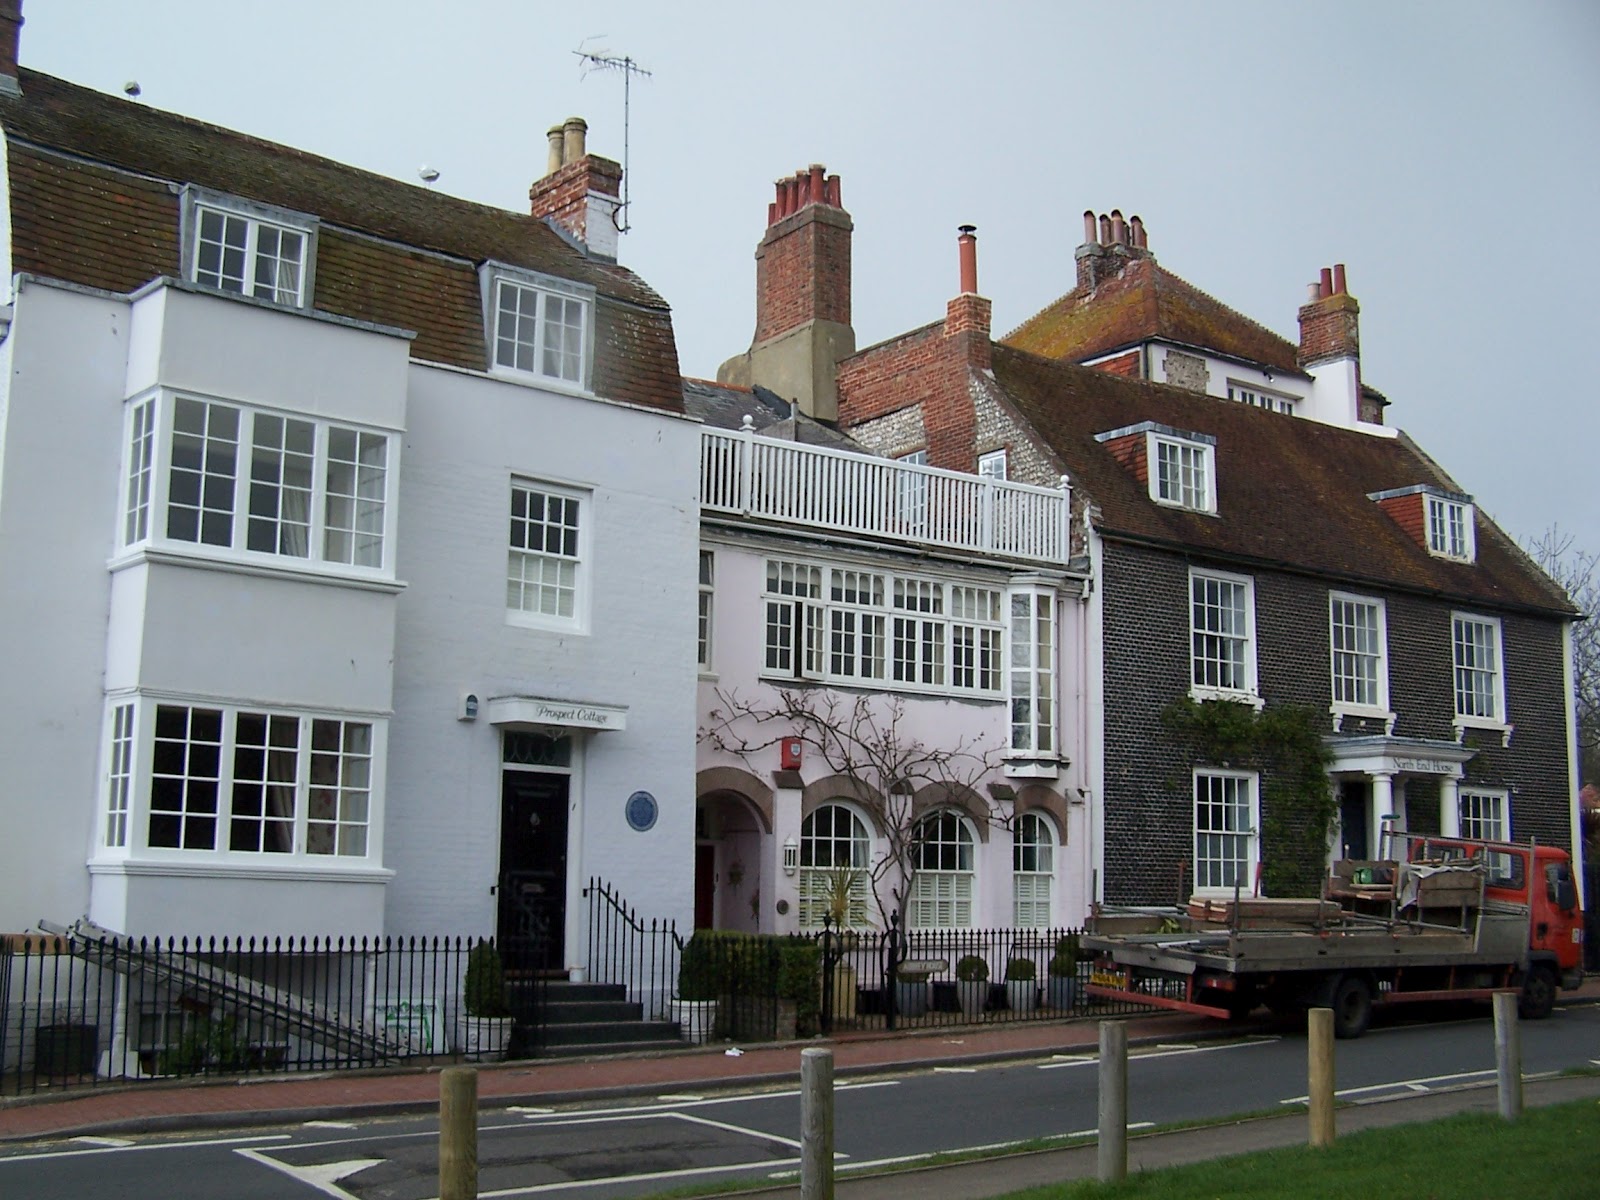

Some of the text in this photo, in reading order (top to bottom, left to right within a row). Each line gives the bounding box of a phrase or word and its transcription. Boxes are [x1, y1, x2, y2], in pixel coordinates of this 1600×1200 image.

[536, 704, 608, 723] Prospect Cottage
[1393, 757, 1454, 773] North End House
